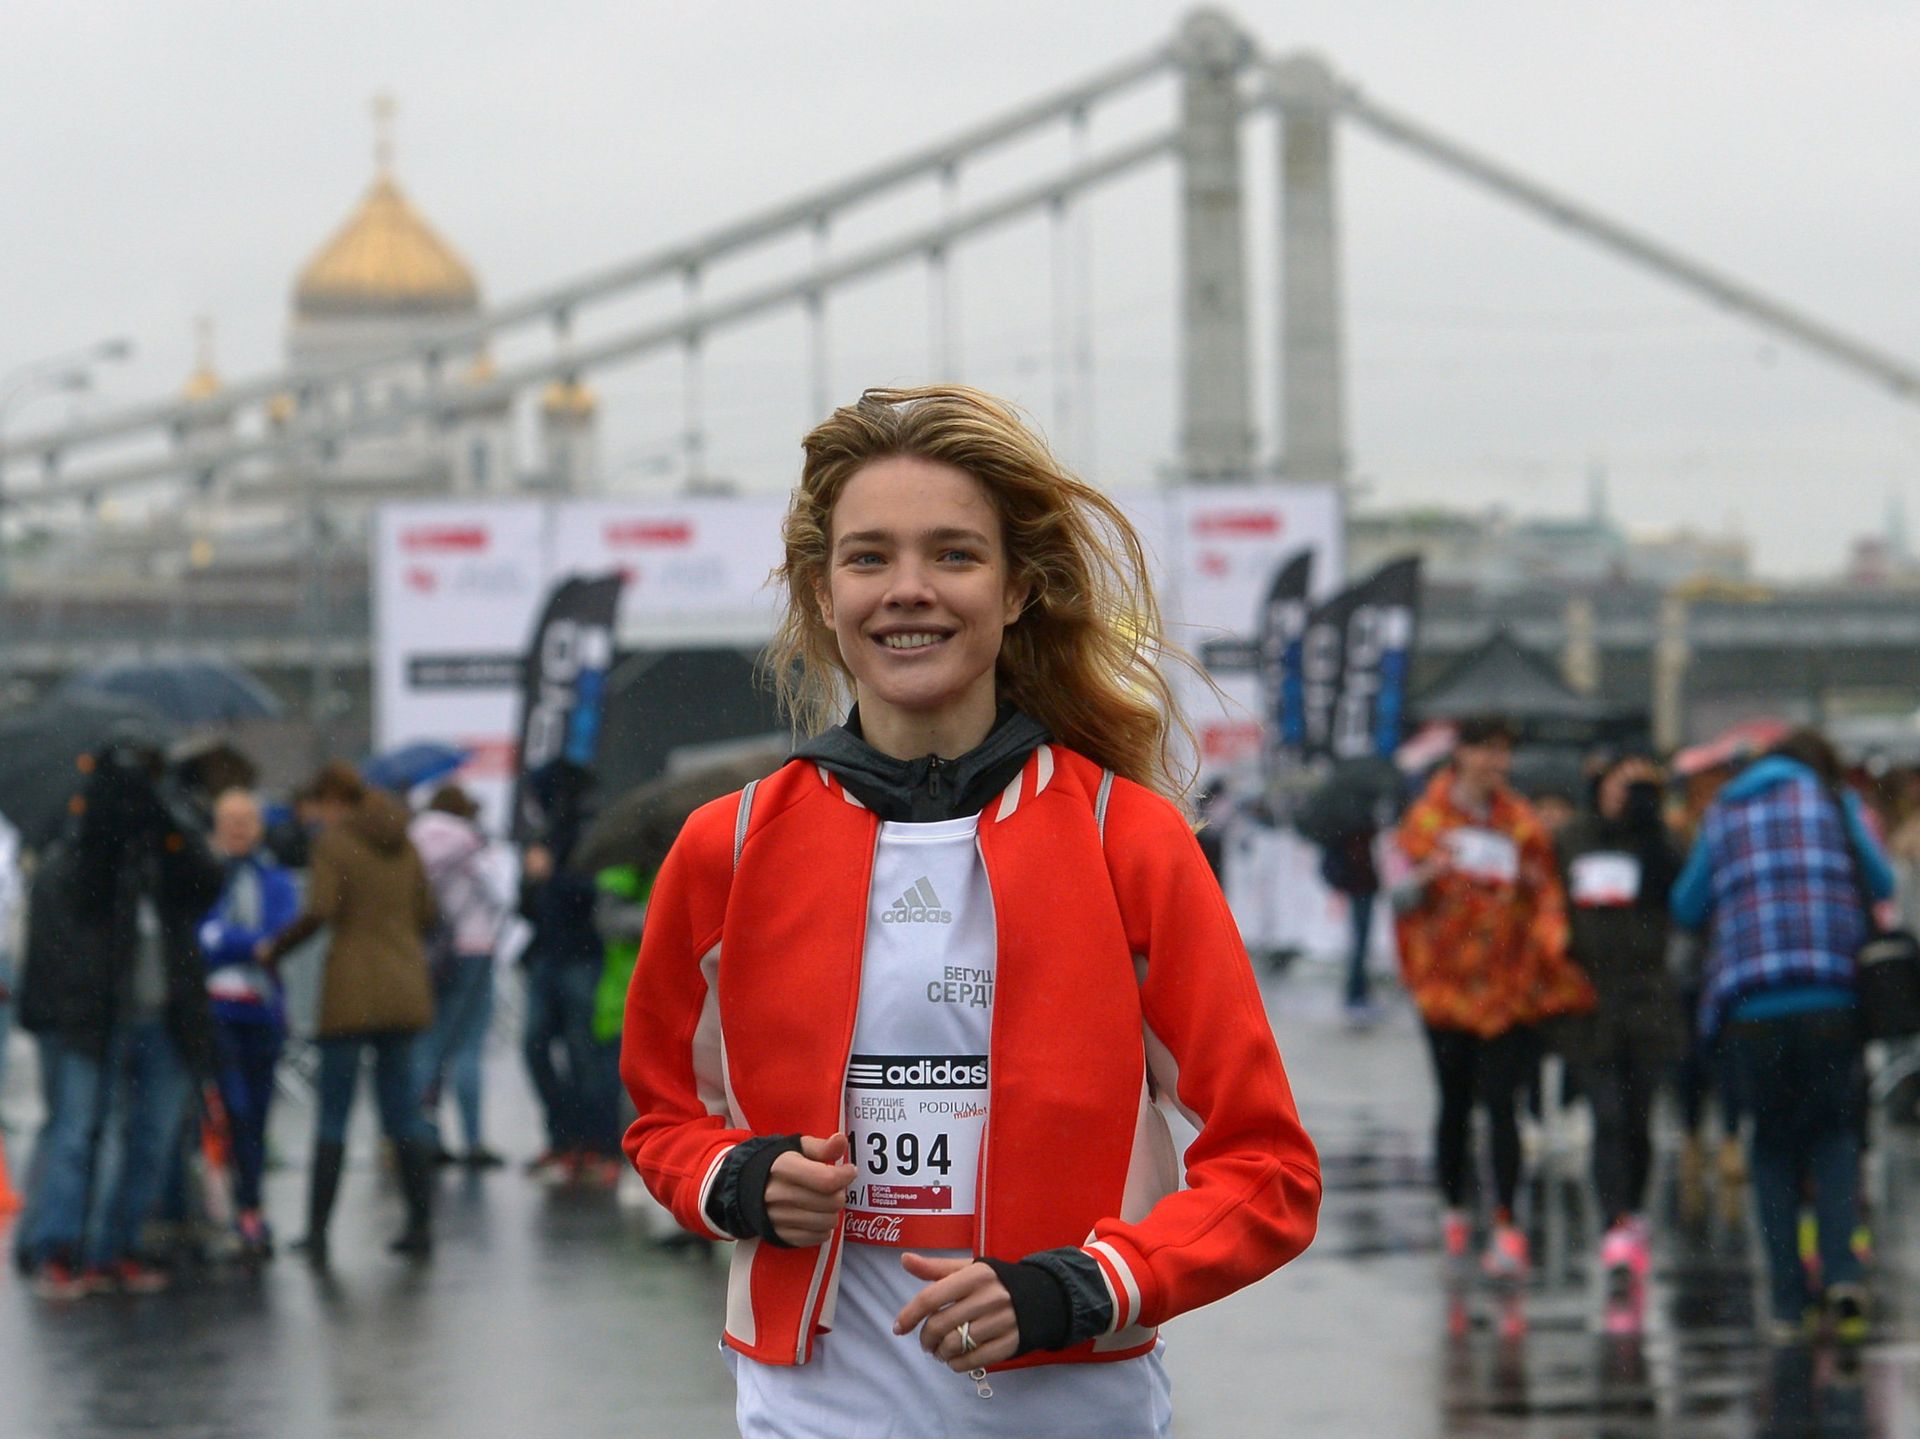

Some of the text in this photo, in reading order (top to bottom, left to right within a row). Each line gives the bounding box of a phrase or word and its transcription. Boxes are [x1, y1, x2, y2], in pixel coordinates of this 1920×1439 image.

[881, 907, 952, 924] adidas
[886, 1060, 987, 1085] adidas
[861, 1097, 905, 1108] БЕГУЩИЕ
[919, 1101, 977, 1114] PODIUM
[854, 1106, 907, 1122] СЕРДЦА
[953, 1106, 988, 1120] market
[848, 1131, 952, 1176] 1394
